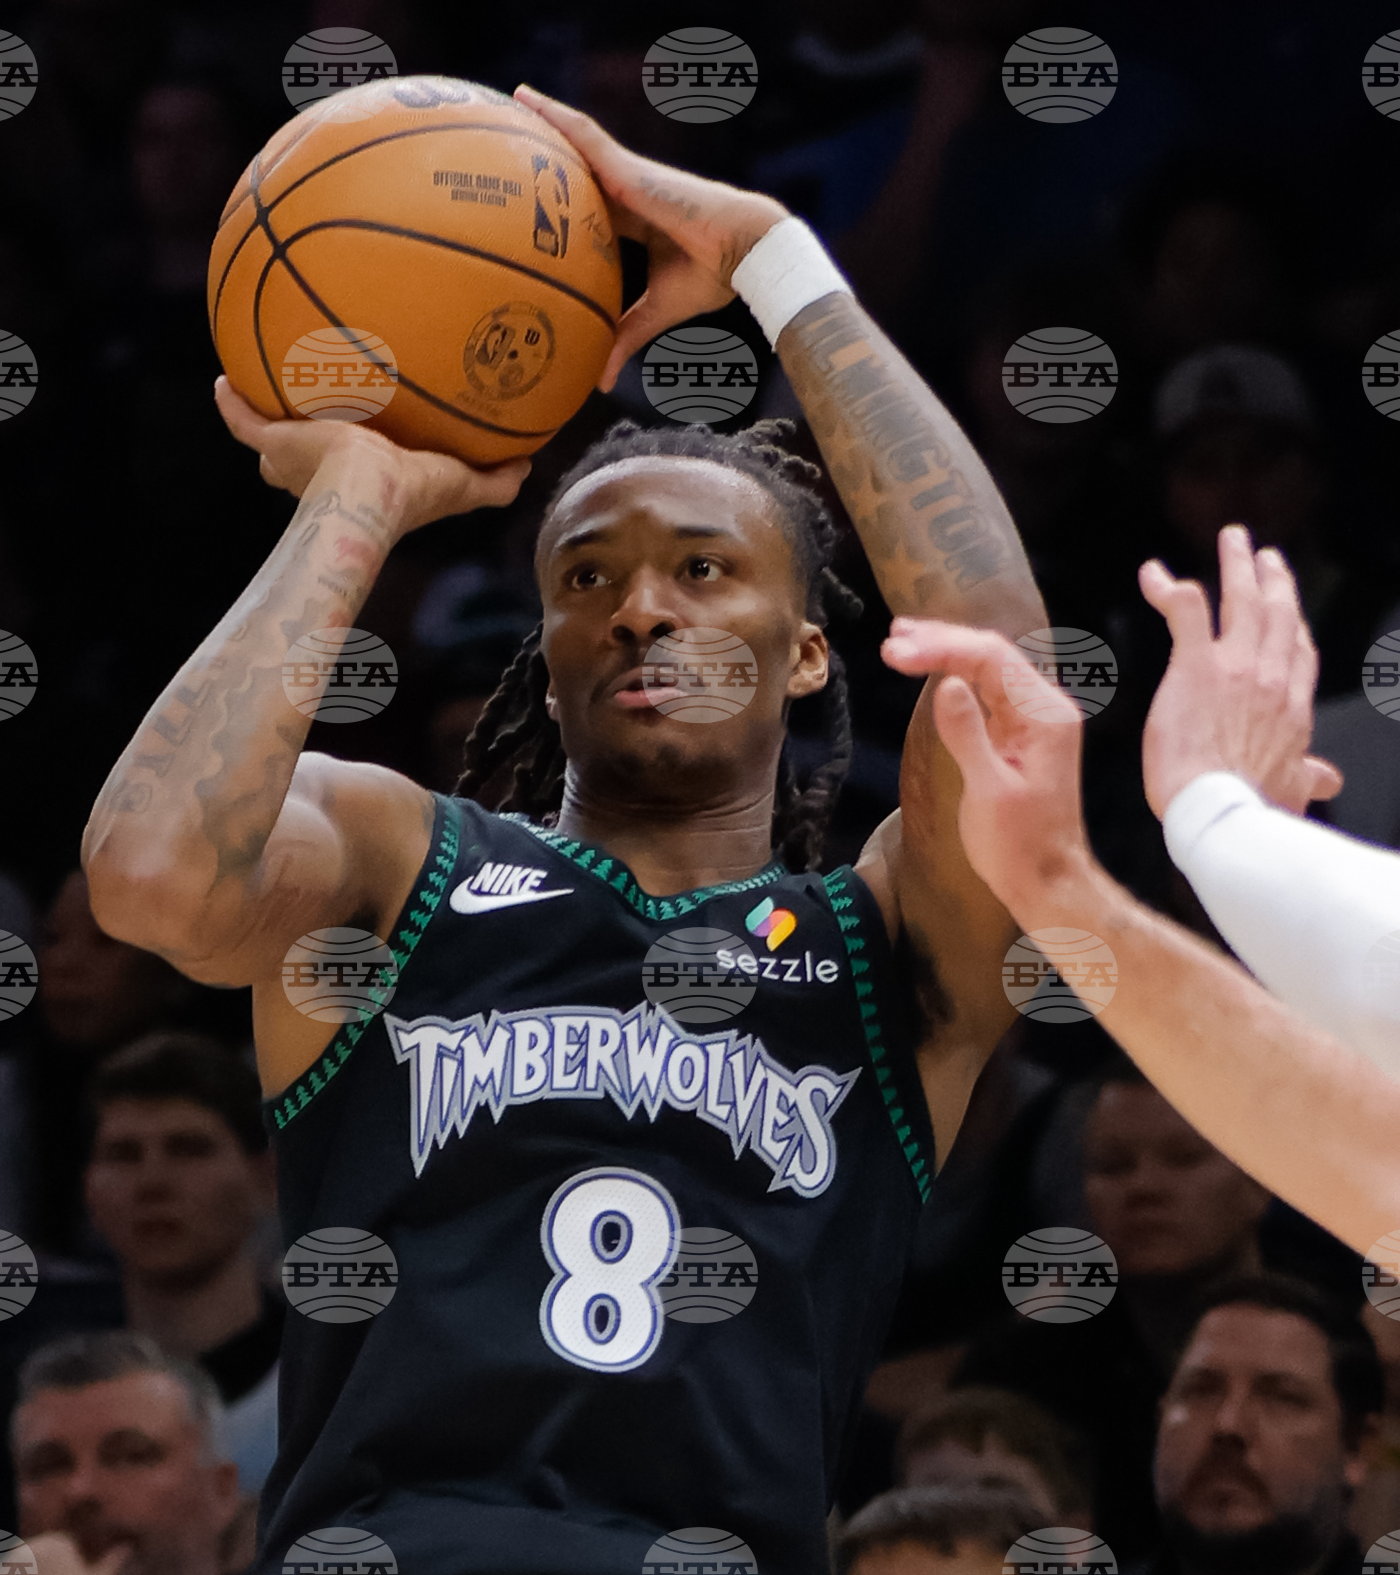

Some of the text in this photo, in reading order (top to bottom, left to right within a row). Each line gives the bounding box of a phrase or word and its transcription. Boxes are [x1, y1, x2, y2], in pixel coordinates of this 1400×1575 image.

[469, 862, 548, 895] NIKE
[716, 949, 839, 984] sezzle
[384, 1000, 863, 1199] TIMBERWOLVES
[539, 1166, 682, 1374] 8
